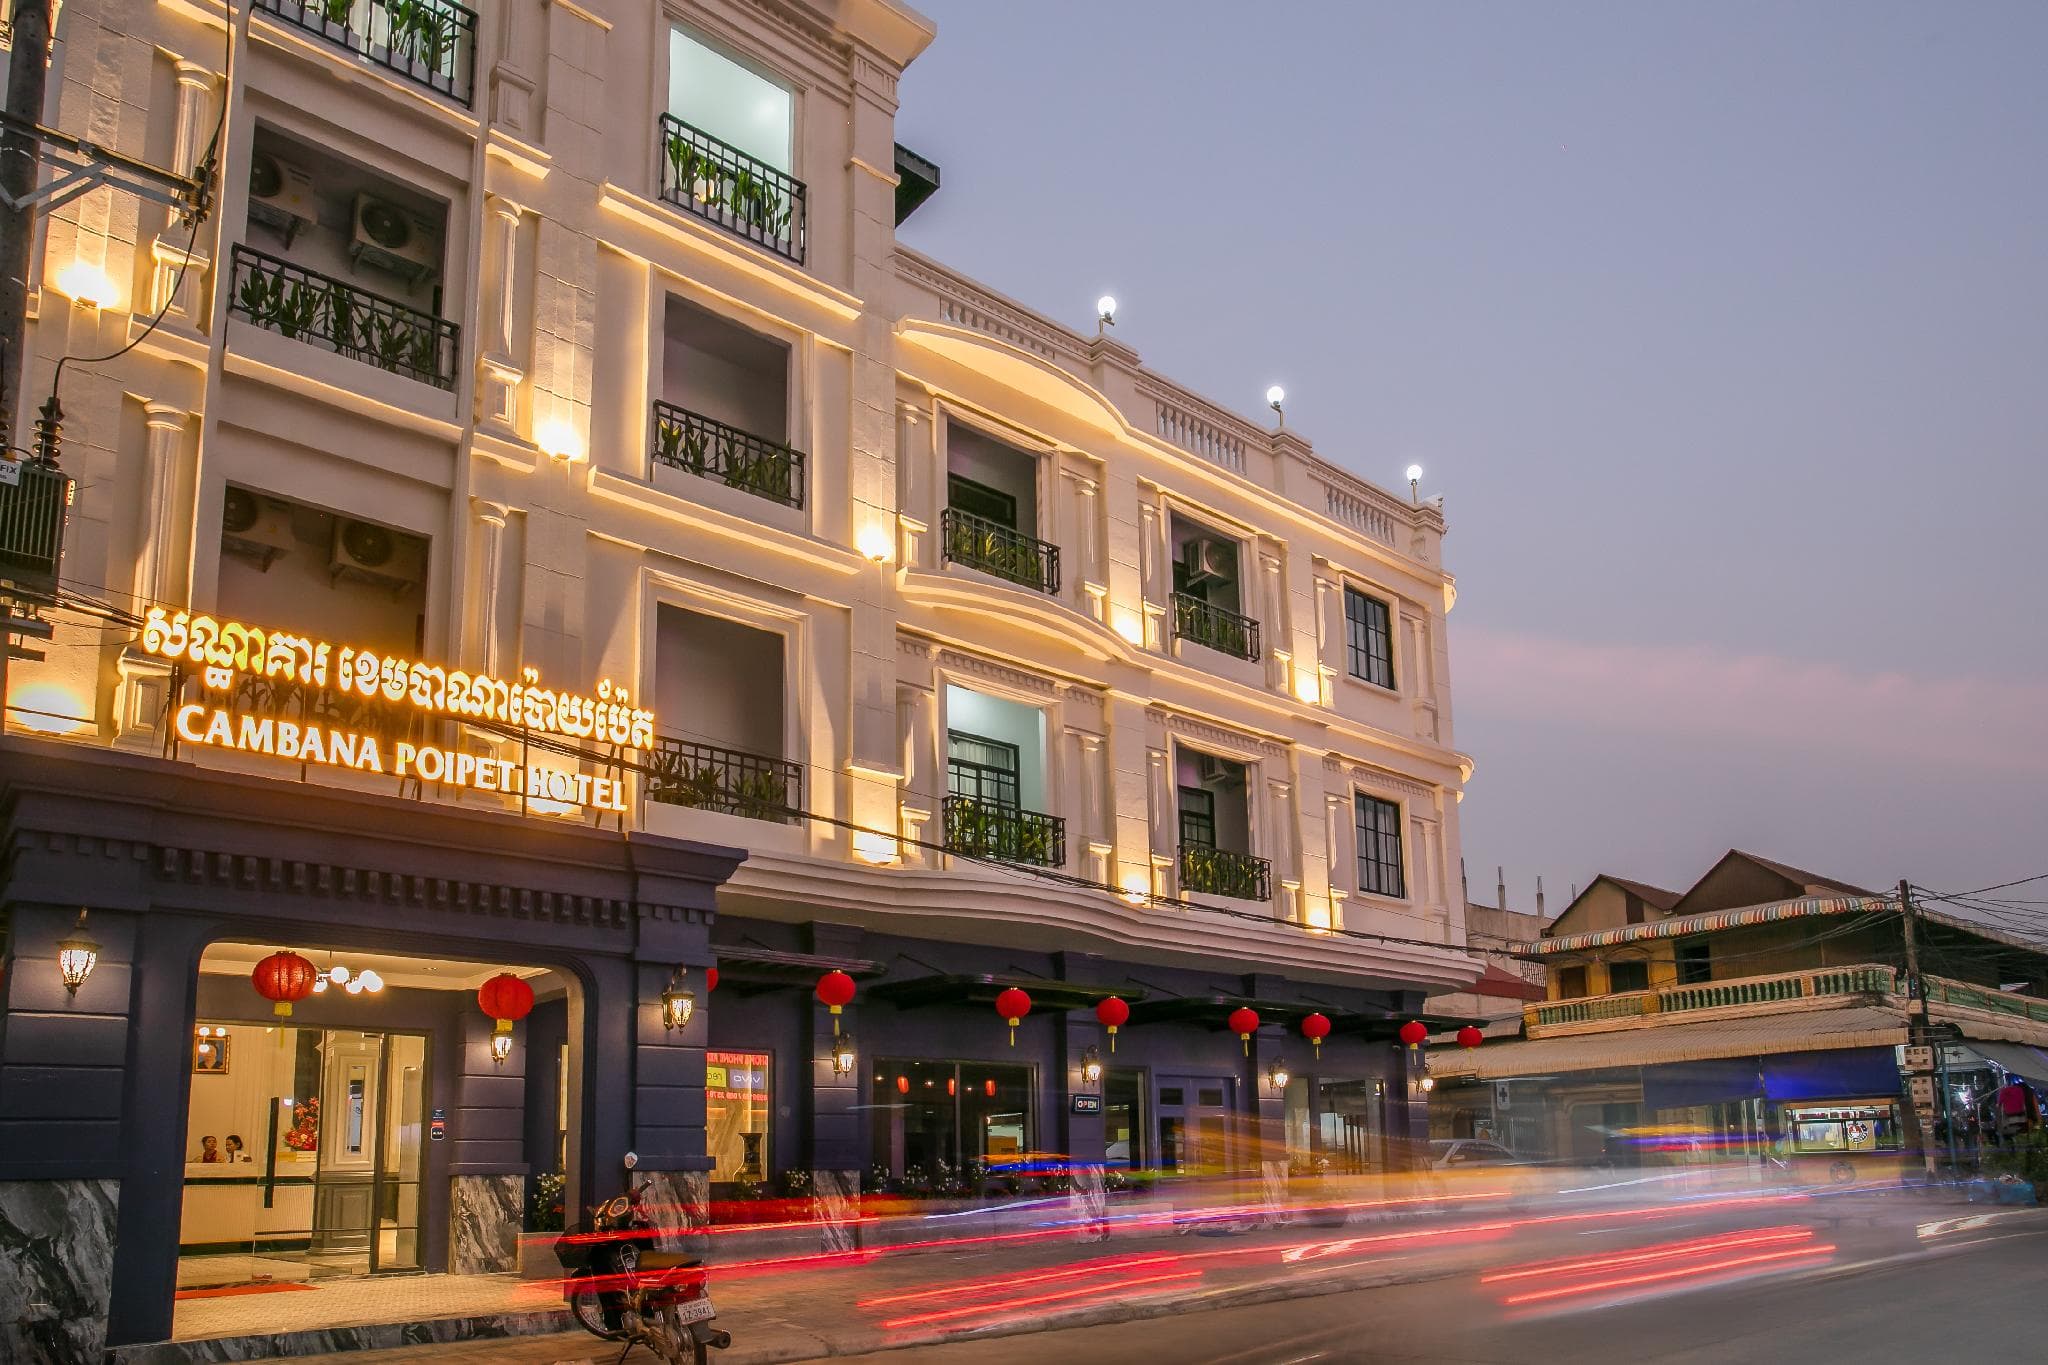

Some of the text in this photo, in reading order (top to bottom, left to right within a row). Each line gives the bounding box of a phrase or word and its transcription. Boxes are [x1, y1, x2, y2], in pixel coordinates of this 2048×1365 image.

[176, 704, 628, 811] CAMBANA POIPET HOTEL
[1077, 1100, 1097, 1109] OPEN
